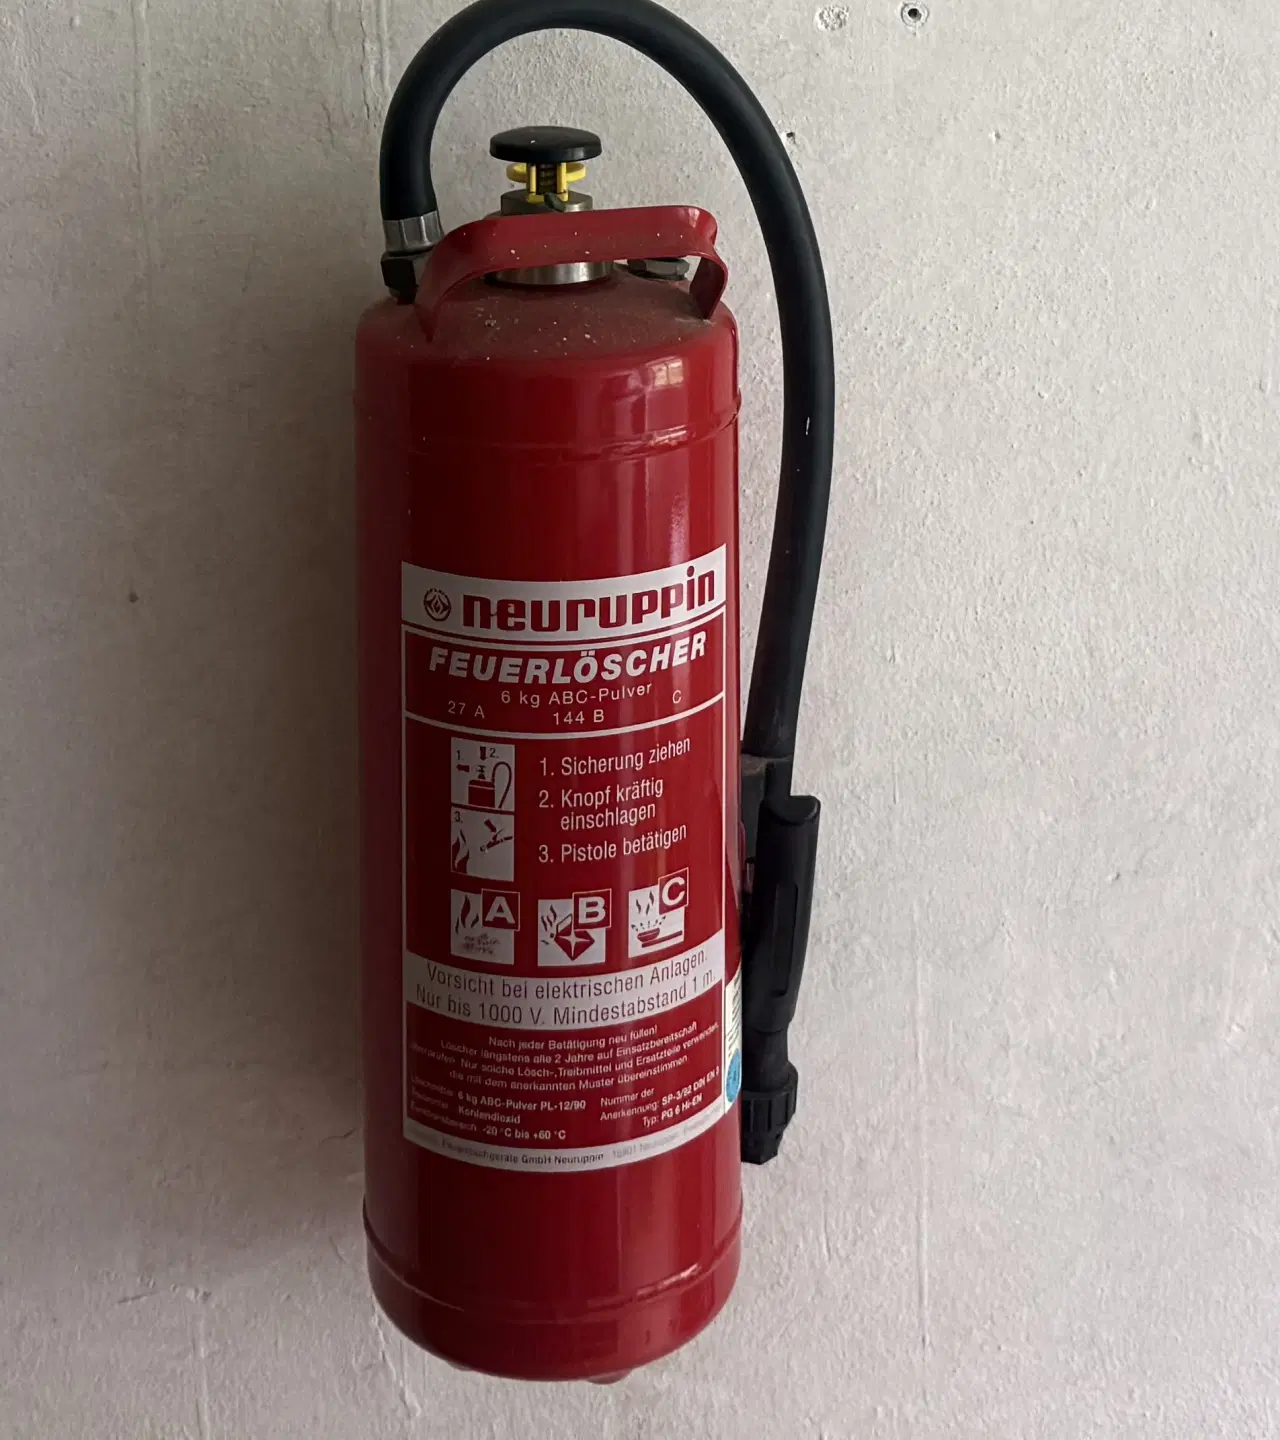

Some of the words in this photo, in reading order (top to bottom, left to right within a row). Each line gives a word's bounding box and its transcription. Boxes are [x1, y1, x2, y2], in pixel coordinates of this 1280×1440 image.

[463, 565, 715, 632] neuruppin
[429, 631, 707, 685] FEUERLÖSCHER
[501, 691, 511, 704] 6
[520, 691, 540, 708] kg
[549, 682, 652, 706] ABC-Pulver
[672, 690, 682, 704] C
[448, 701, 466, 715] 27
[474, 705, 485, 719] A
[553, 711, 585, 725] 144
[593, 709, 605, 723] B
[540, 758, 555, 776] 1.
[561, 752, 644, 776] Sicherung
[648, 737, 691, 764] ziehen
[538, 790, 554, 808] 2.
[561, 786, 611, 810] Knopf
[616, 777, 664, 803] kräftig
[561, 803, 656, 831] einschlagen
[538, 844, 554, 863] 3.
[561, 840, 617, 863] Pistole
[623, 824, 687, 855] betätigen
[662, 876, 686, 906] C
[485, 896, 516, 924] A
[578, 896, 606, 924] B
[426, 962, 494, 997] Vorsicht
[502, 980, 528, 999] bei
[535, 977, 644, 1000] elektrischen
[650, 949, 708, 986] Anlagen.
[416, 984, 441, 1009] Nur
[448, 994, 471, 1017] bis
[479, 1003, 522, 1024] 1000
[529, 1007, 545, 1025] V.
[553, 980, 687, 1025] Mindestabstand
[692, 976, 697, 993] 1
[488, 1036, 516, 1048] Nach
[548, 1037, 606, 1051] Betätigung
[609, 1032, 627, 1046] neu
[555, 1054, 562, 1063] 2
[564, 1051, 595, 1063] Jahre
[597, 1047, 613, 1060] auf
[616, 1020, 697, 1057] Einsatzbereitschaft
[510, 1078, 576, 1091] anerkannten
[578, 1077, 614, 1090] Muster
[618, 1054, 688, 1084] übereinstimmen
[615, 1060, 634, 1071] und
[480, 1096, 537, 1110] ABC-Pulver
[600, 1093, 638, 1107] Nummer
[641, 1087, 655, 1098] der
